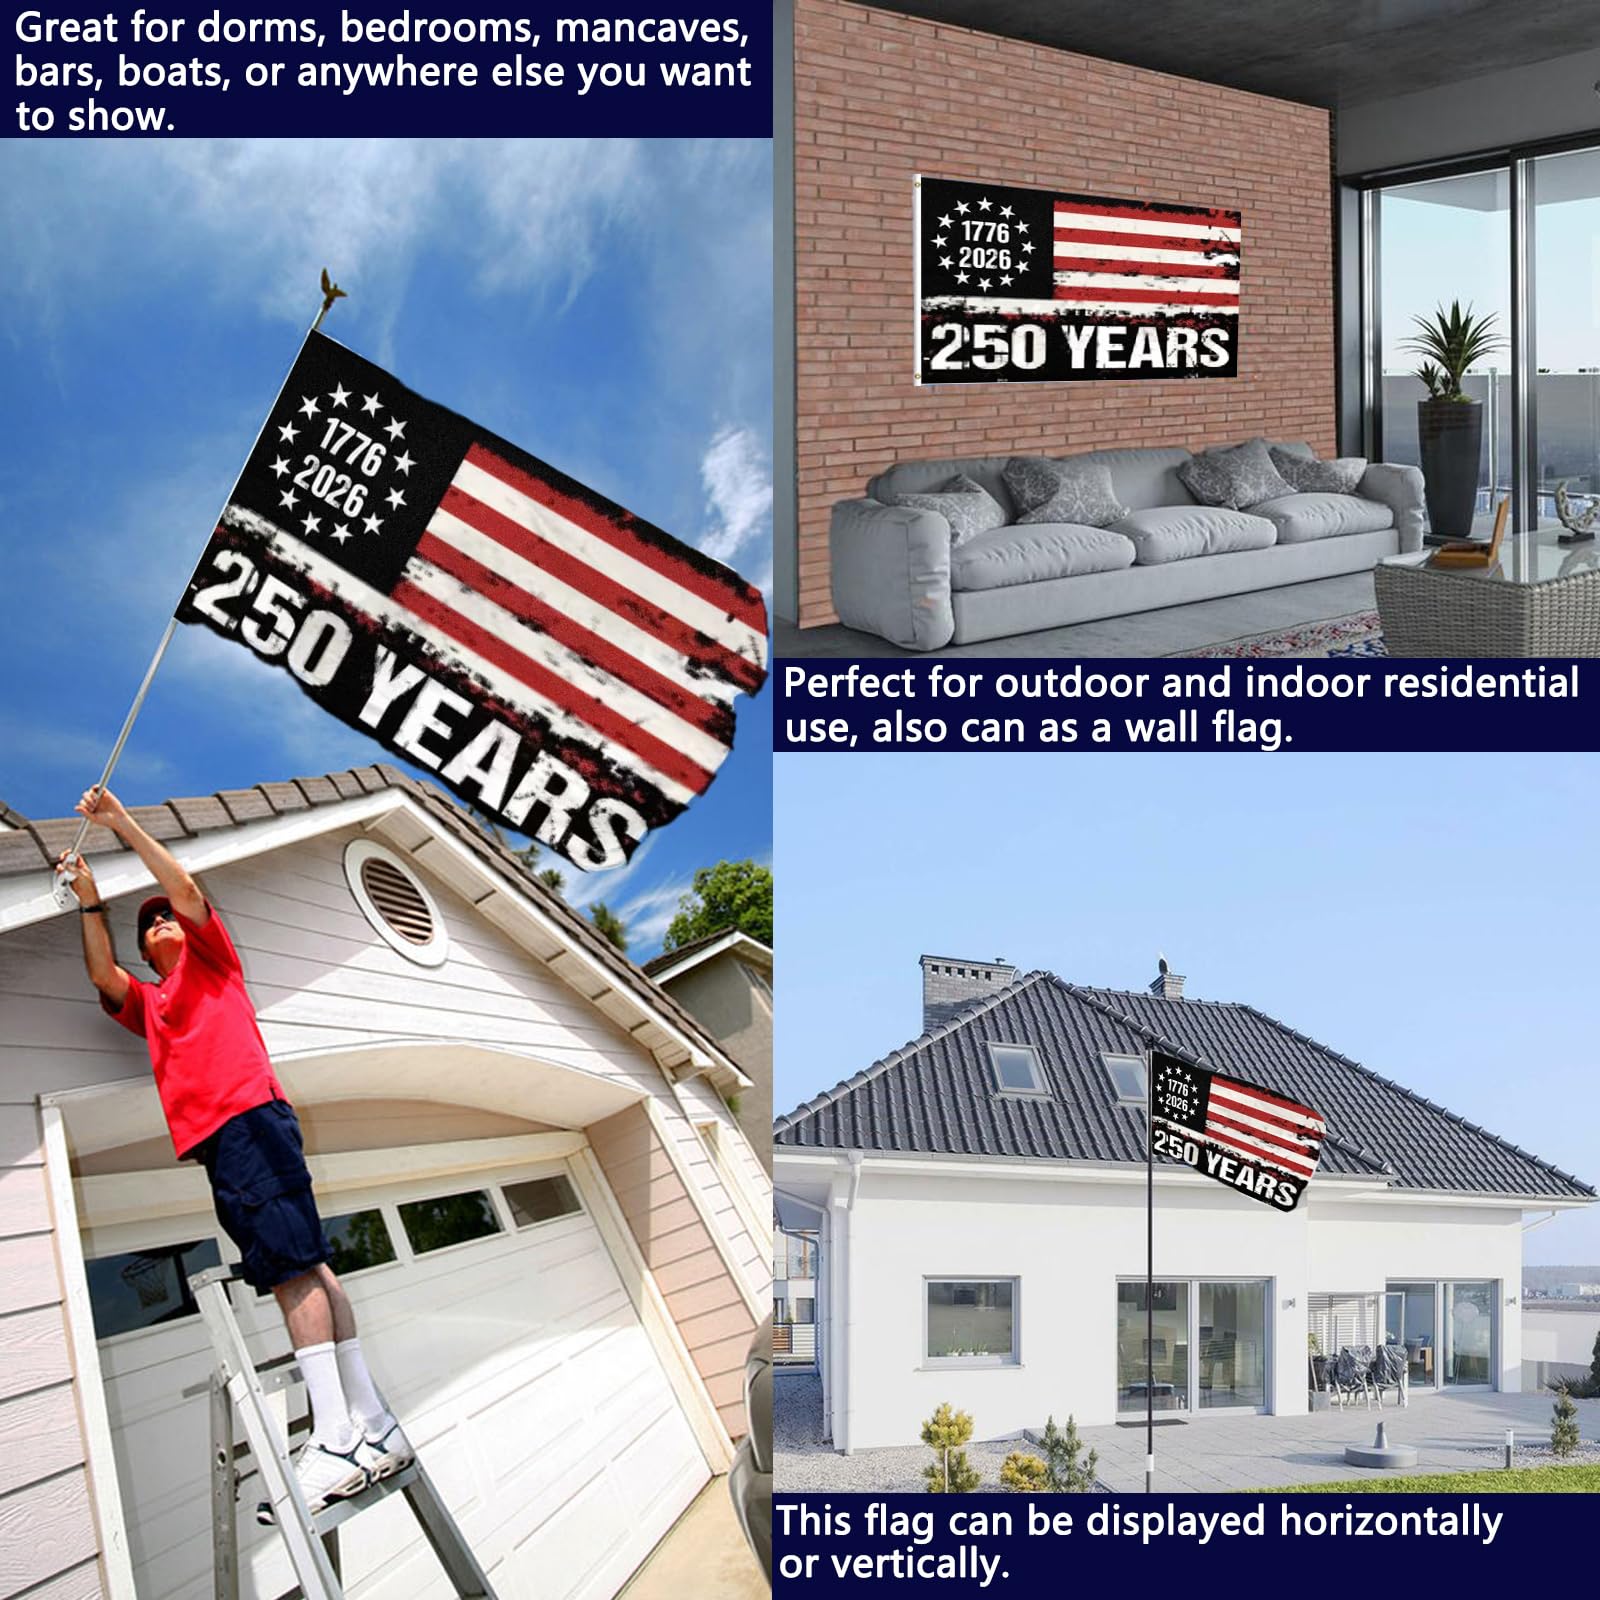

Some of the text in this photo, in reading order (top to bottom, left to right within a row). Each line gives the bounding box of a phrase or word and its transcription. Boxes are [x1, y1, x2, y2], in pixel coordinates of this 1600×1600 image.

[960, 219, 1010, 245] 1776
[958, 246, 1012, 271] 2026
[929, 322, 1230, 371] 250 YEARS
[319, 417, 387, 477] 1776
[293, 454, 369, 519] 2026
[191, 549, 648, 872] 250 YEARS
[1165, 1092, 1189, 1112] 2026
[1166, 1078, 1189, 1097] 1776
[1153, 1129, 1298, 1207] 250 YEARS
